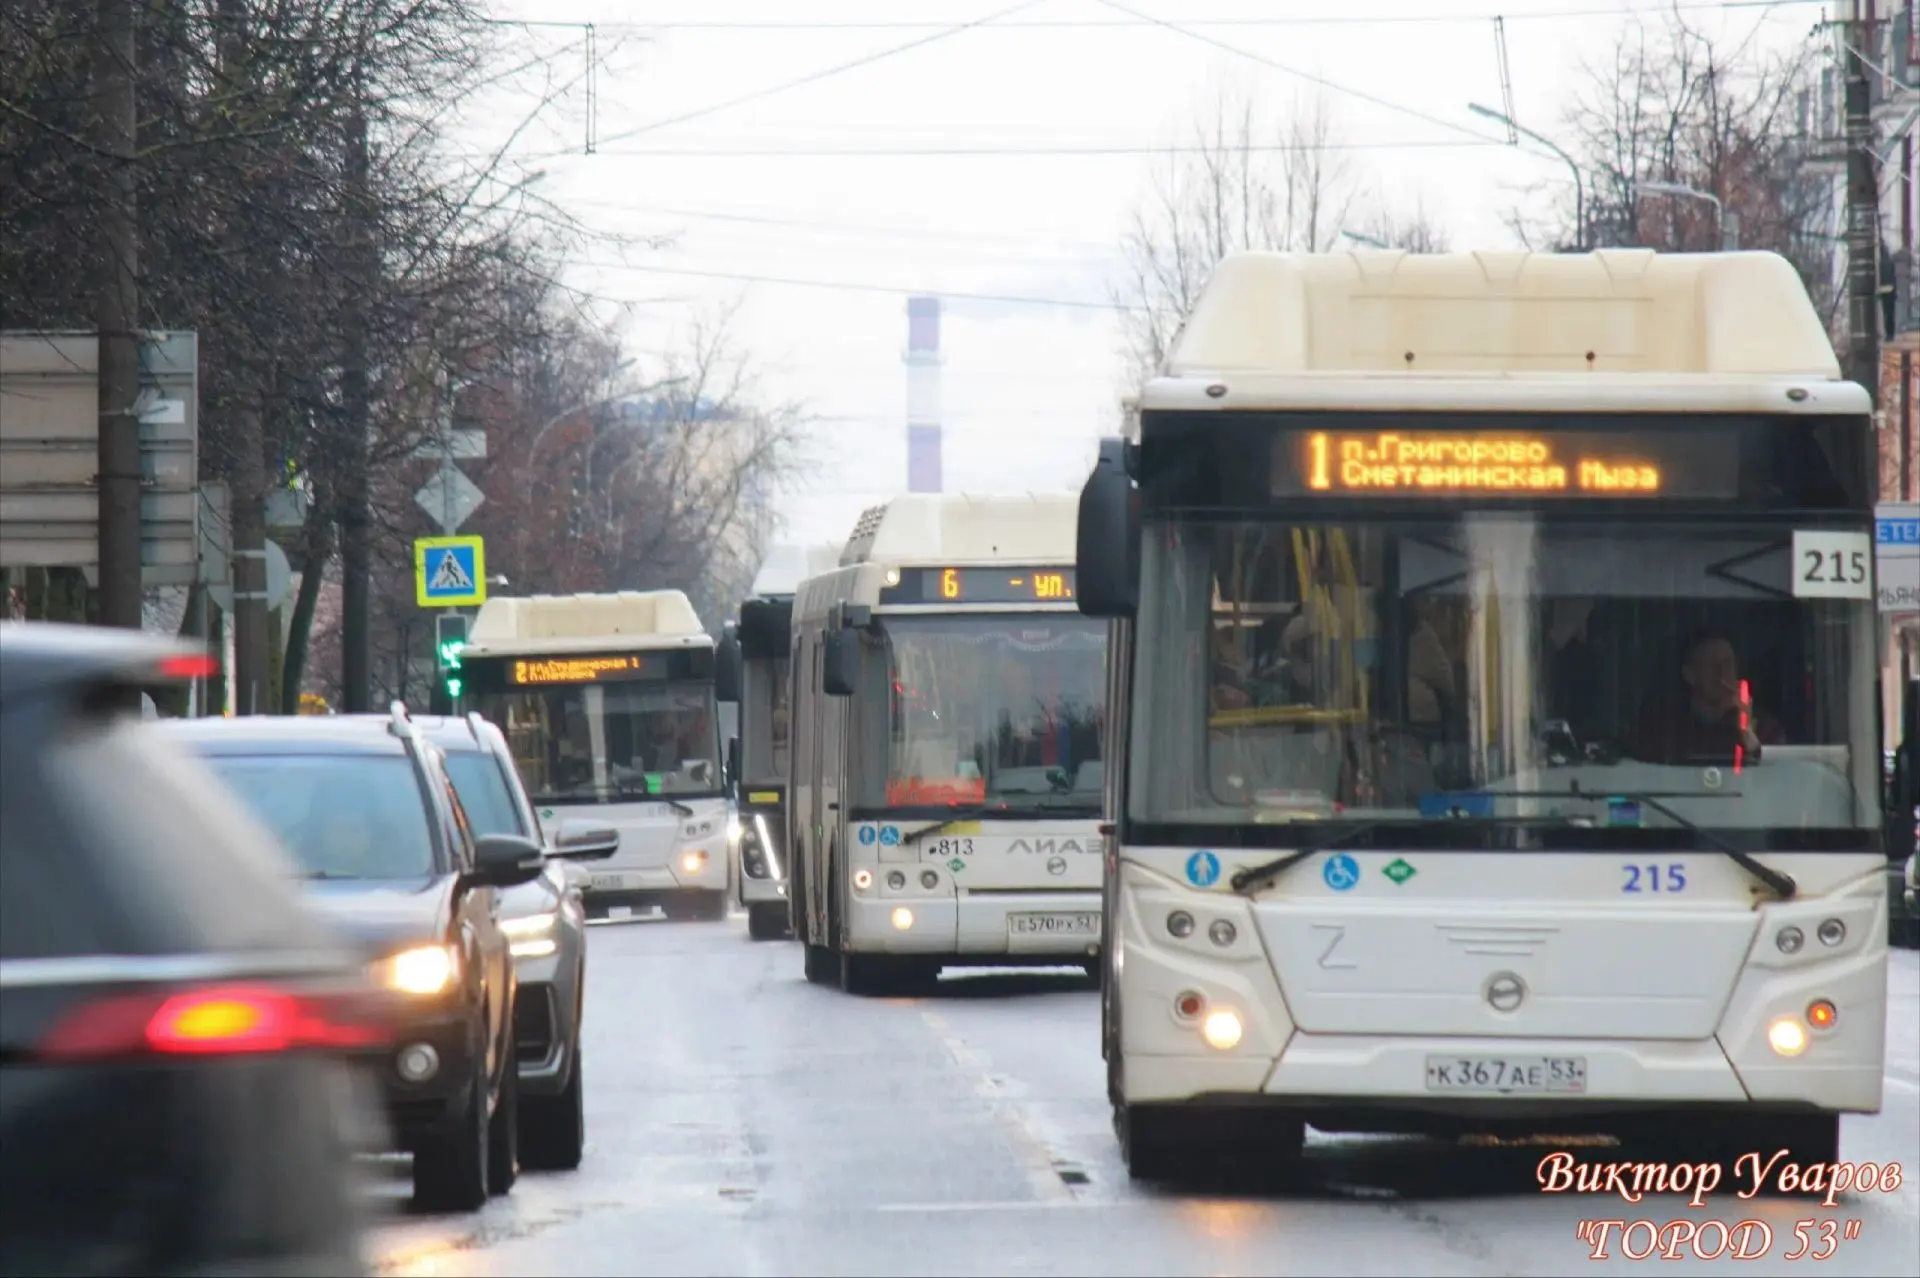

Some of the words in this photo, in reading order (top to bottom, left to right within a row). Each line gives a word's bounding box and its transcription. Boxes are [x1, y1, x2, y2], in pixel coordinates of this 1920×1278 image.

[1309, 431, 1330, 490] 1
[1342, 434, 1546, 464] п.Григорово
[1342, 459, 1566, 488] Сметанинская
[1580, 460, 1658, 488] Мыза
[1804, 549, 1866, 584] 215
[944, 569, 958, 598] 6
[1034, 575, 1071, 597] ул.
[938, 838, 974, 856] 813
[1622, 865, 1686, 893] 215
[1551, 1060, 1576, 1080] 53
